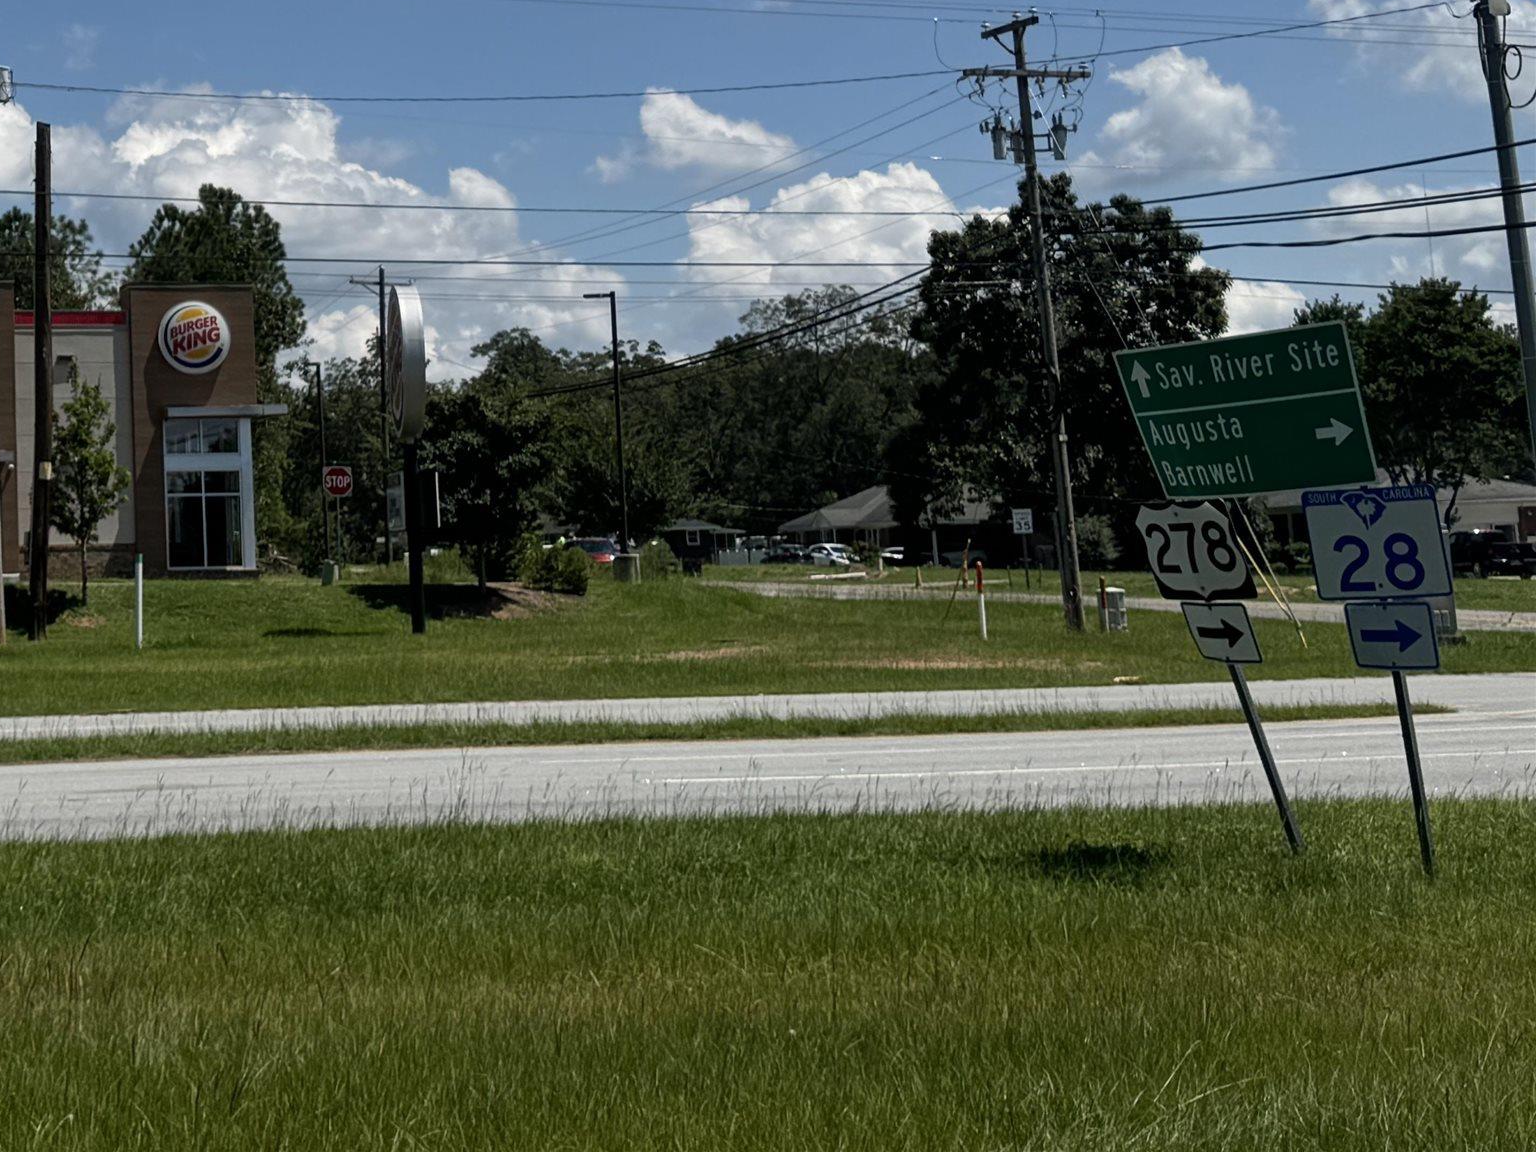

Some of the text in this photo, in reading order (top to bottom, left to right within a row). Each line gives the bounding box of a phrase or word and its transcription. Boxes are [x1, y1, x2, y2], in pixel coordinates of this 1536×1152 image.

[170, 316, 218, 339] BURGER
[172, 327, 220, 355] KING
[1155, 339, 1340, 390] Sav. River Site
[1149, 413, 1244, 450] Augusta
[325, 475, 351, 488] STOP
[1161, 454, 1255, 487] Barnwell
[1307, 486, 1431, 504] SOUTH CAROLINA
[1145, 520, 1236, 574] 278
[1333, 532, 1425, 592] 28
